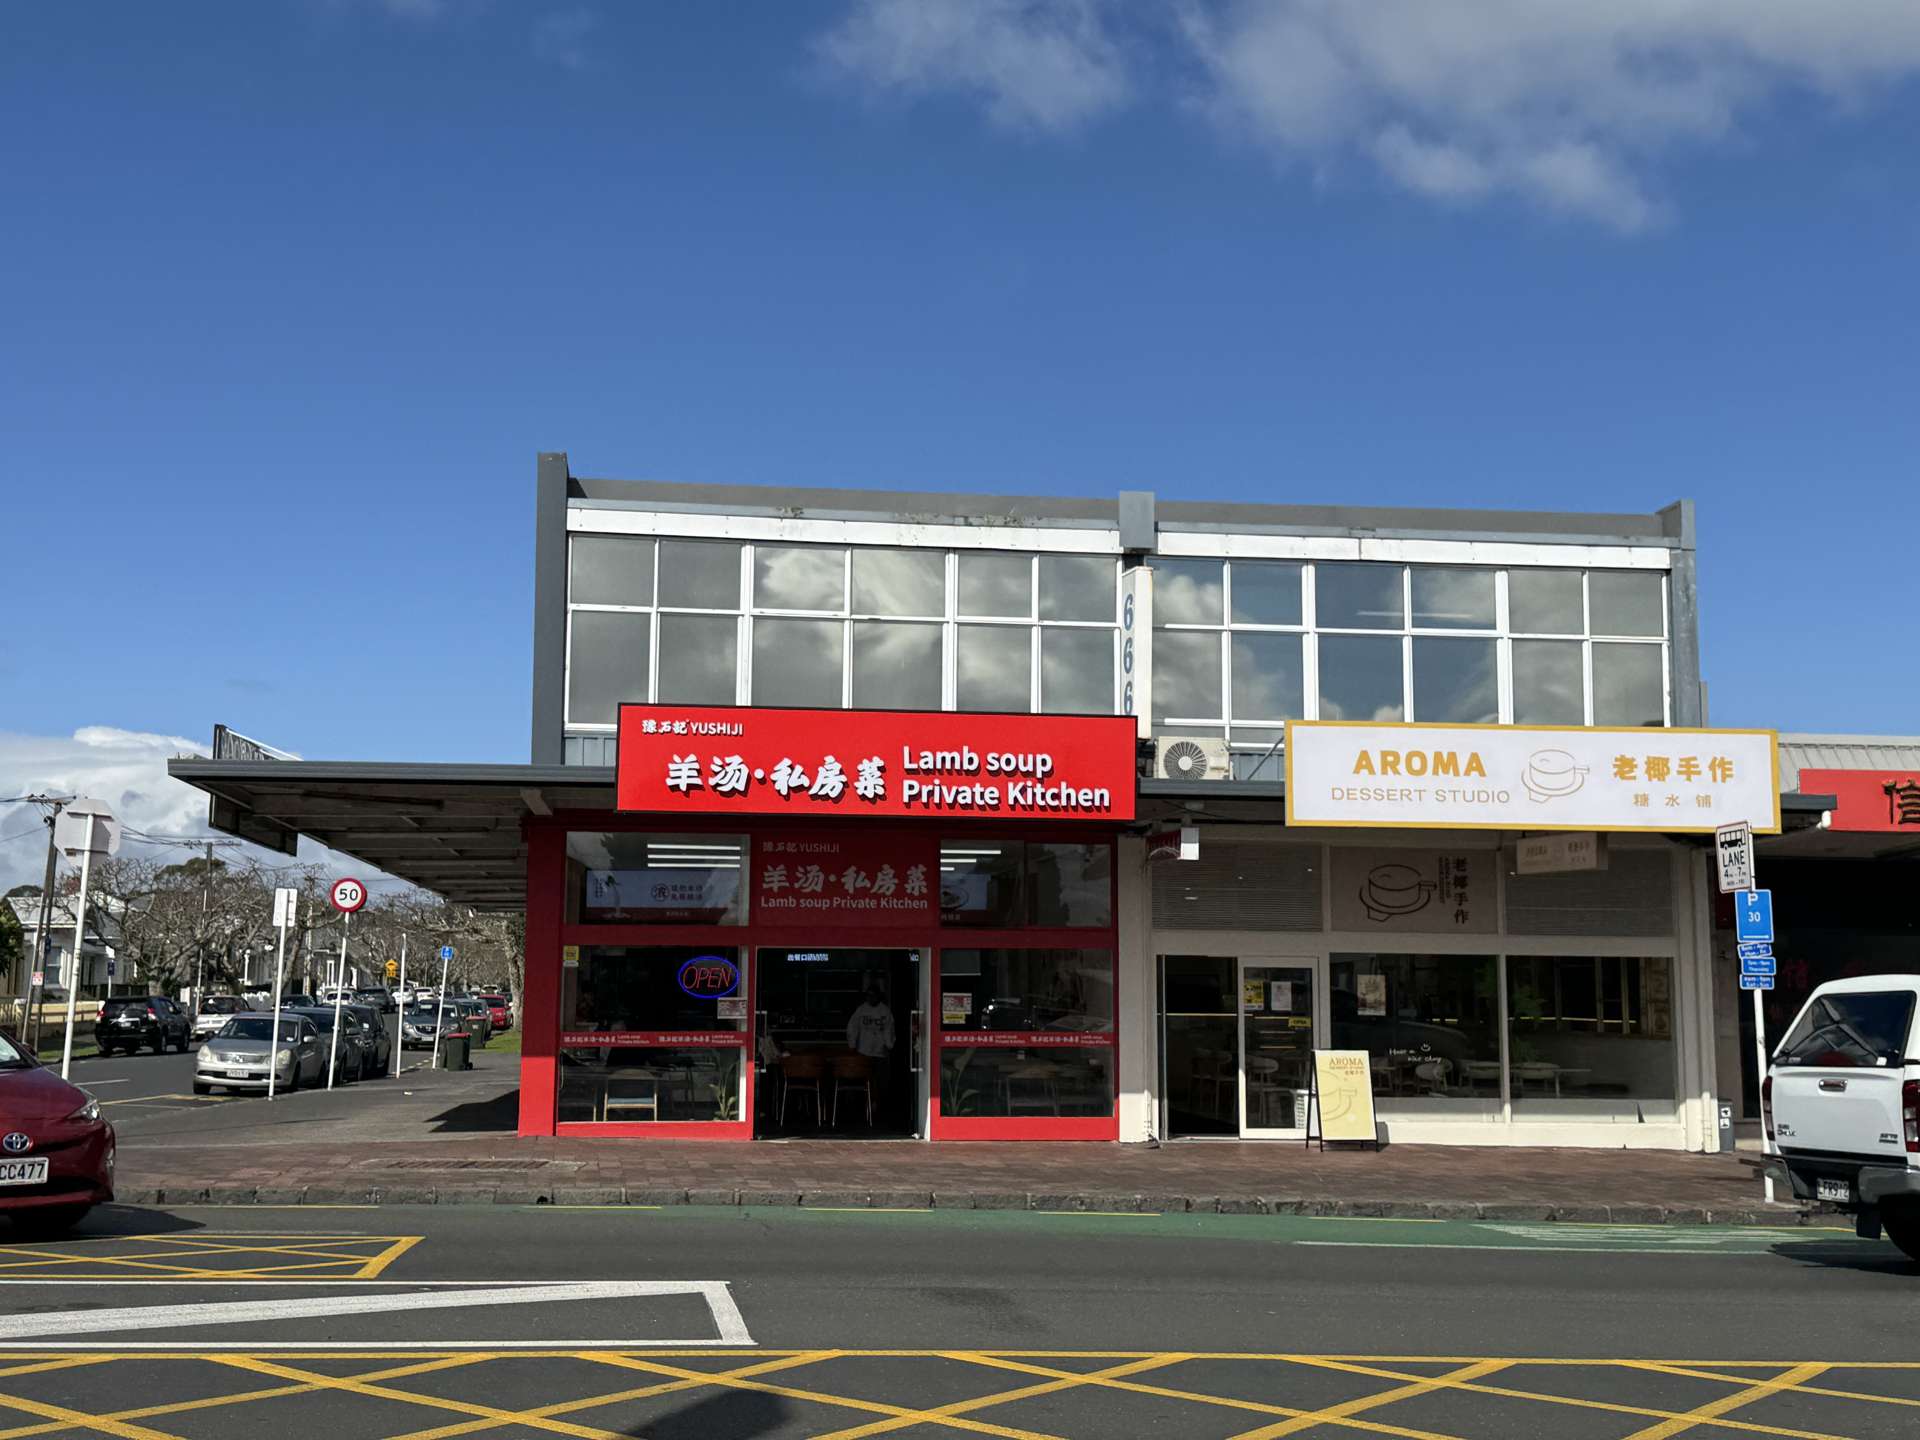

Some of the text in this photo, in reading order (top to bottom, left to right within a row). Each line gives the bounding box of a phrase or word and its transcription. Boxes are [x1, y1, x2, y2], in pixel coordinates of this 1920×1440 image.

[690, 721, 743, 736] YUSHIJI
[902, 745, 1053, 779] Lamb soup
[1352, 750, 1488, 778] AROMA
[1612, 754, 1735, 784] 老椰手作
[664, 752, 886, 799] 羊汤·私房菜
[902, 778, 1111, 808] Private Kitchen
[1331, 786, 1511, 804] DESSERT STUDIO
[799, 842, 840, 854] YUSHIJI
[1722, 850, 1746, 868] LANE
[761, 863, 929, 897] 羊汤·私房菜
[339, 888, 359, 901] 50
[760, 896, 929, 911] Lamb soup Private Kitchen
[1747, 892, 1759, 907] P
[1747, 911, 1761, 923] 30
[682, 965, 733, 990] OPEN
[1328, 1057, 1365, 1066] AROMA
